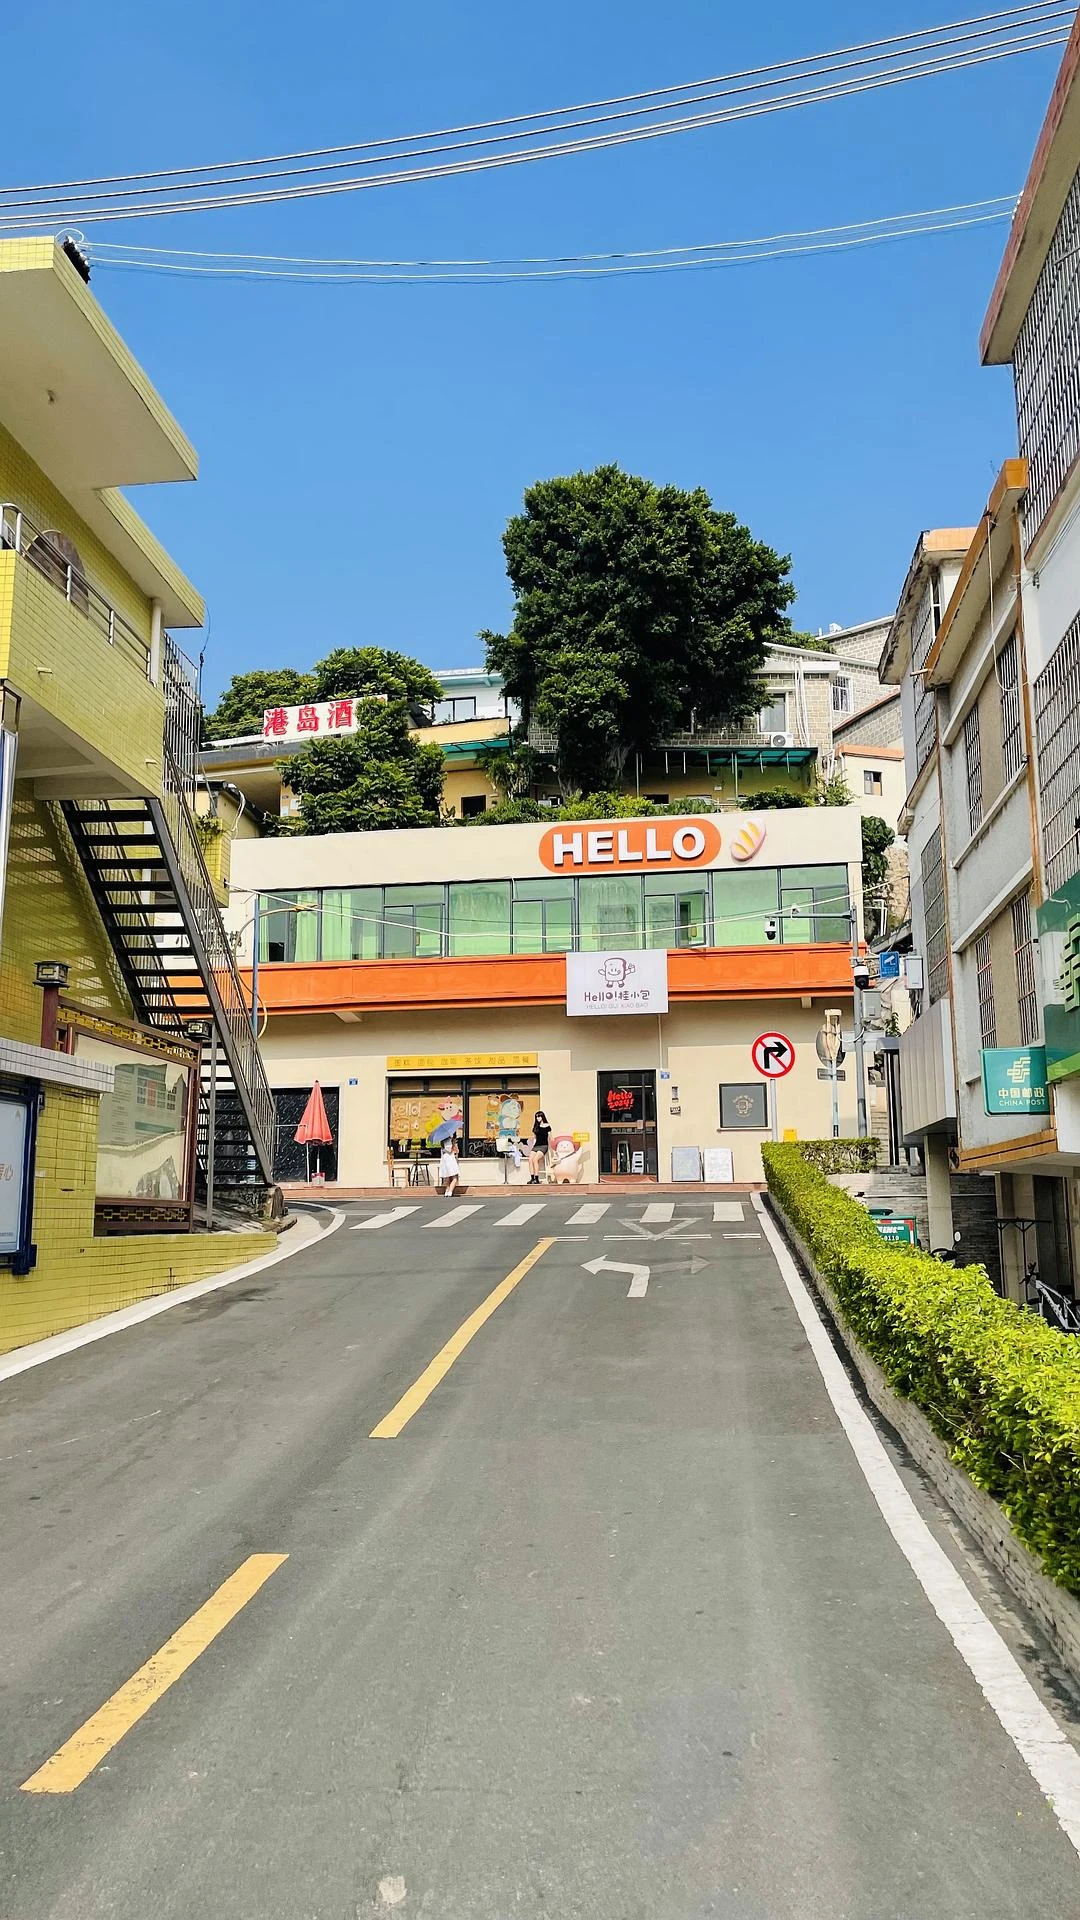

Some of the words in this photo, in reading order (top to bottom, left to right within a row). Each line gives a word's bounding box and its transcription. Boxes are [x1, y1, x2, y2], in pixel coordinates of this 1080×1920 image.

[263, 700, 354, 736] 港岛酒
[553, 826, 706, 865] HELLO
[998, 1087, 1045, 1099] 中国邮政
[999, 1099, 1024, 1107] CHINA
